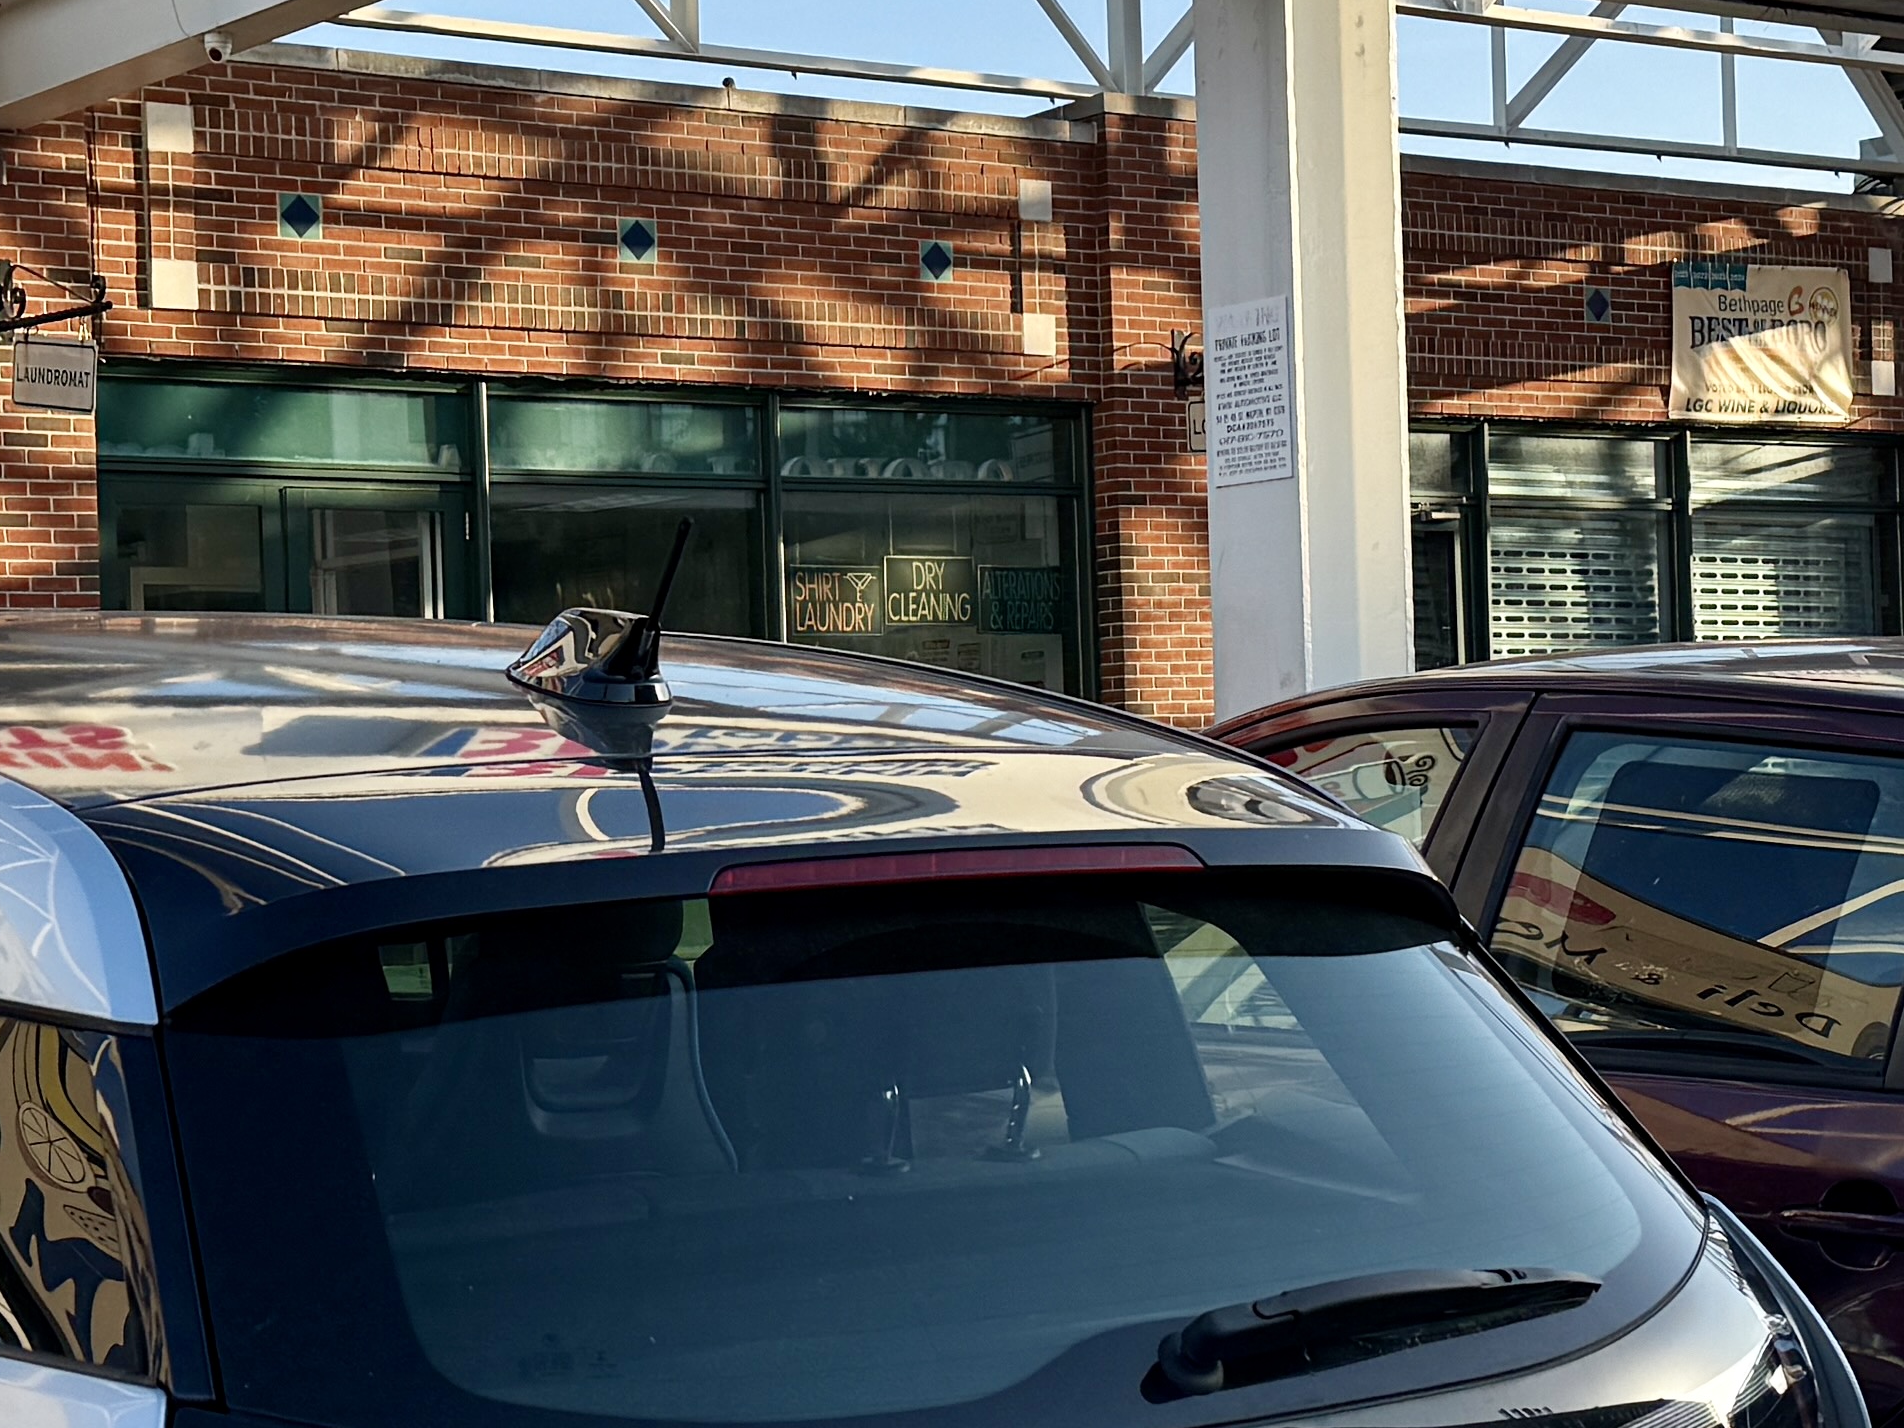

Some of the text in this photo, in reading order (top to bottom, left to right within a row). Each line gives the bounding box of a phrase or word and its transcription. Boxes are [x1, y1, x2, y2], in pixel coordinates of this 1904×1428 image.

[1718, 294, 1784, 317] Bethpage
[1689, 315, 1748, 349] BEST
[15, 363, 92, 389] LAUNDROMAT
[1685, 397, 1714, 413] LGC
[1717, 398, 1756, 414] WINE
[1759, 399, 1770, 414] &
[795, 572, 841, 602] SHIRT
[912, 561, 945, 591] DRY
[981, 572, 1061, 600] ALTERATIONS
[795, 602, 875, 633] LAUNDRY
[887, 592, 971, 622] CLEANING
[989, 601, 1054, 631] & REPAIRS
